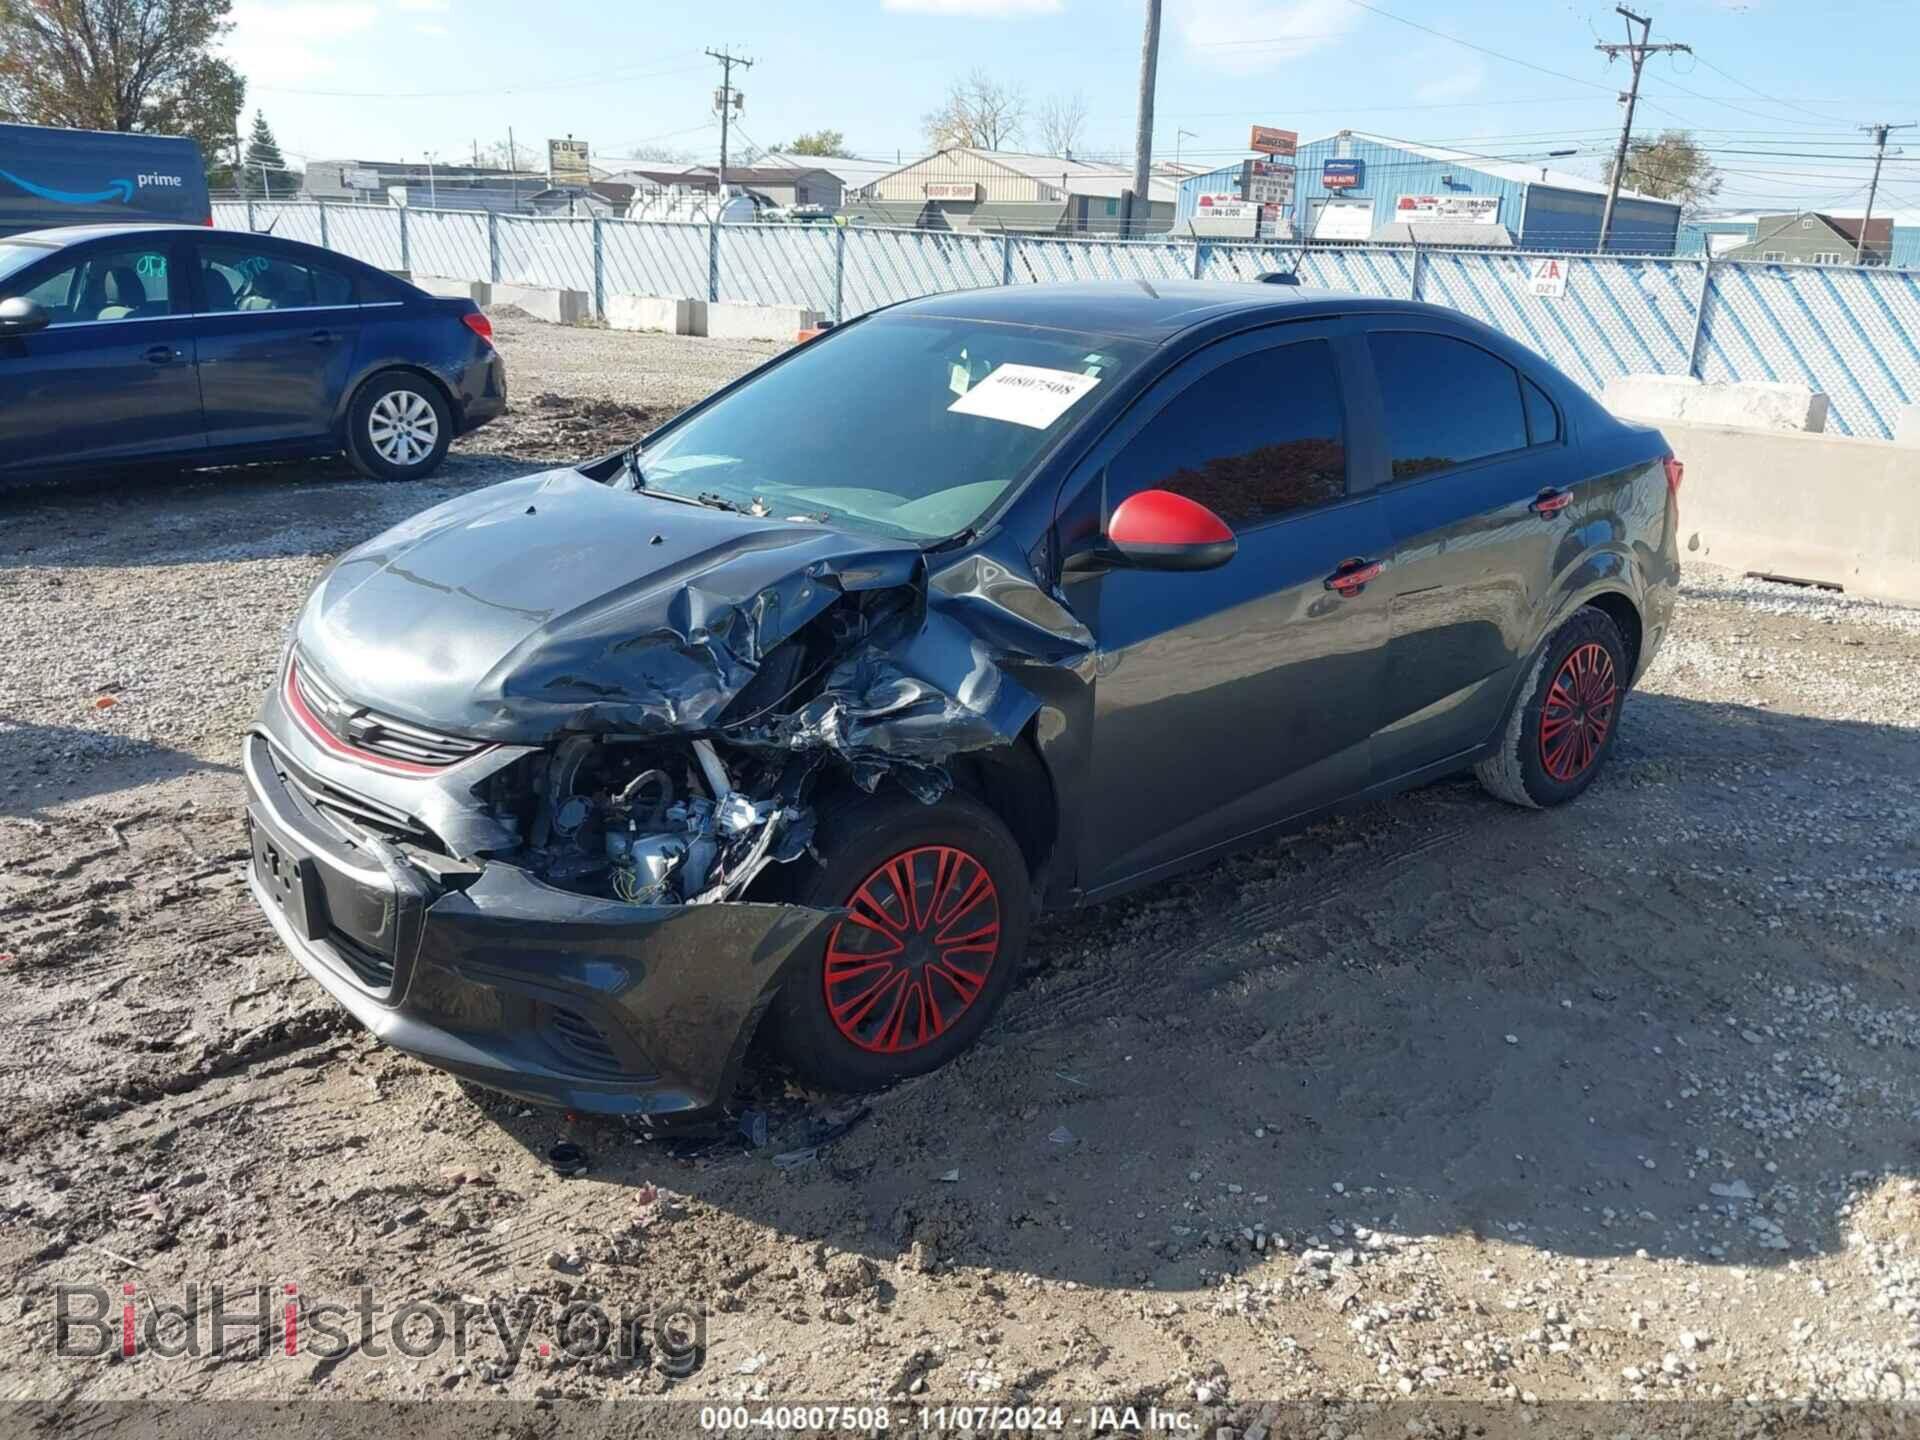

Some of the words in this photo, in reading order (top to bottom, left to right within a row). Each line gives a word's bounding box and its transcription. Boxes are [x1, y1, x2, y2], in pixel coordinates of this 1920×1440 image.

[138, 171, 182, 188] prime
[928, 186, 950, 197] BODY
[952, 186, 974, 197] SHOP
[997, 374, 1076, 396] 40807508
